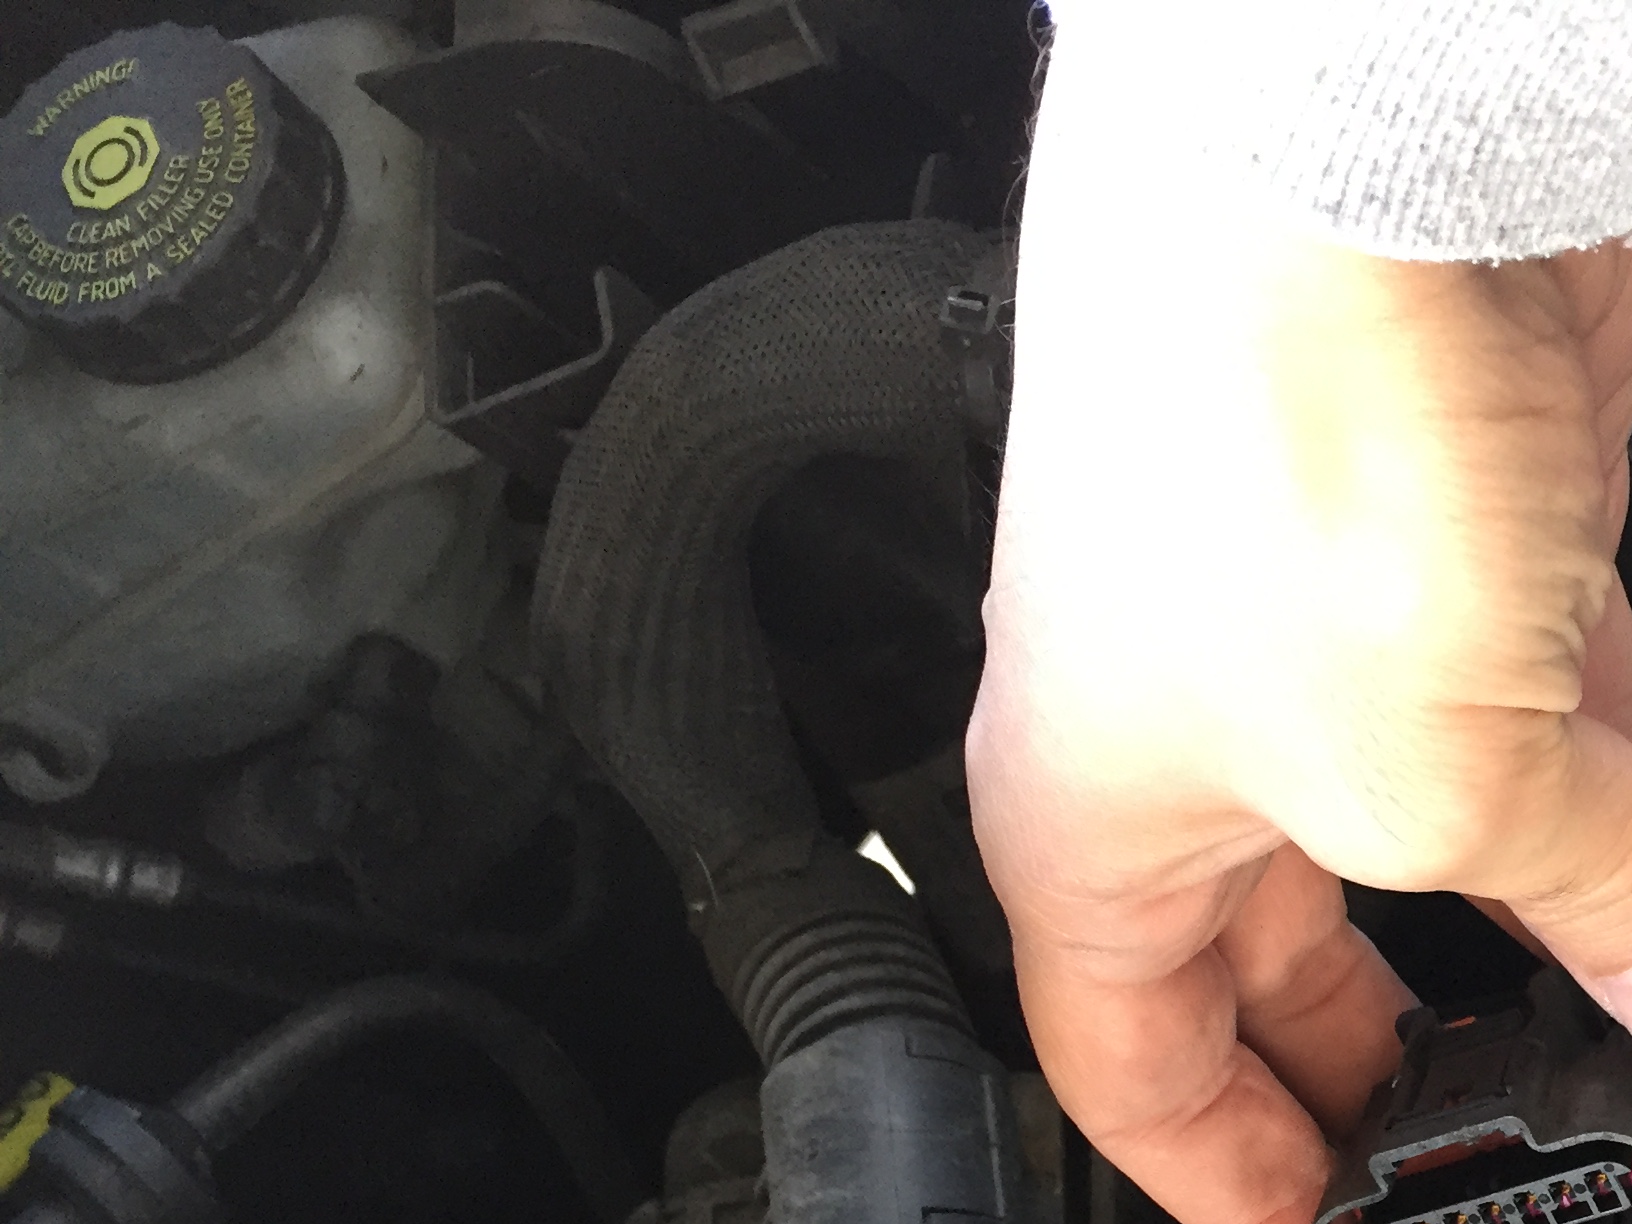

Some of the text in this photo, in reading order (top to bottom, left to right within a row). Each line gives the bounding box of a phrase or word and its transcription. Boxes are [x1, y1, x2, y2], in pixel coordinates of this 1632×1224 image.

[27, 58, 136, 136] WARNING!
[7, 97, 224, 273] CAP BEFORE REMOVING USE ONLY
[16, 270, 69, 304] FLUID
[78, 271, 137, 304] FROM
[147, 262, 162, 282] A
[167, 191, 233, 264] SEALED
[224, 76, 256, 184] CONTAINER
[67, 154, 189, 244] CLEAN FILLER
